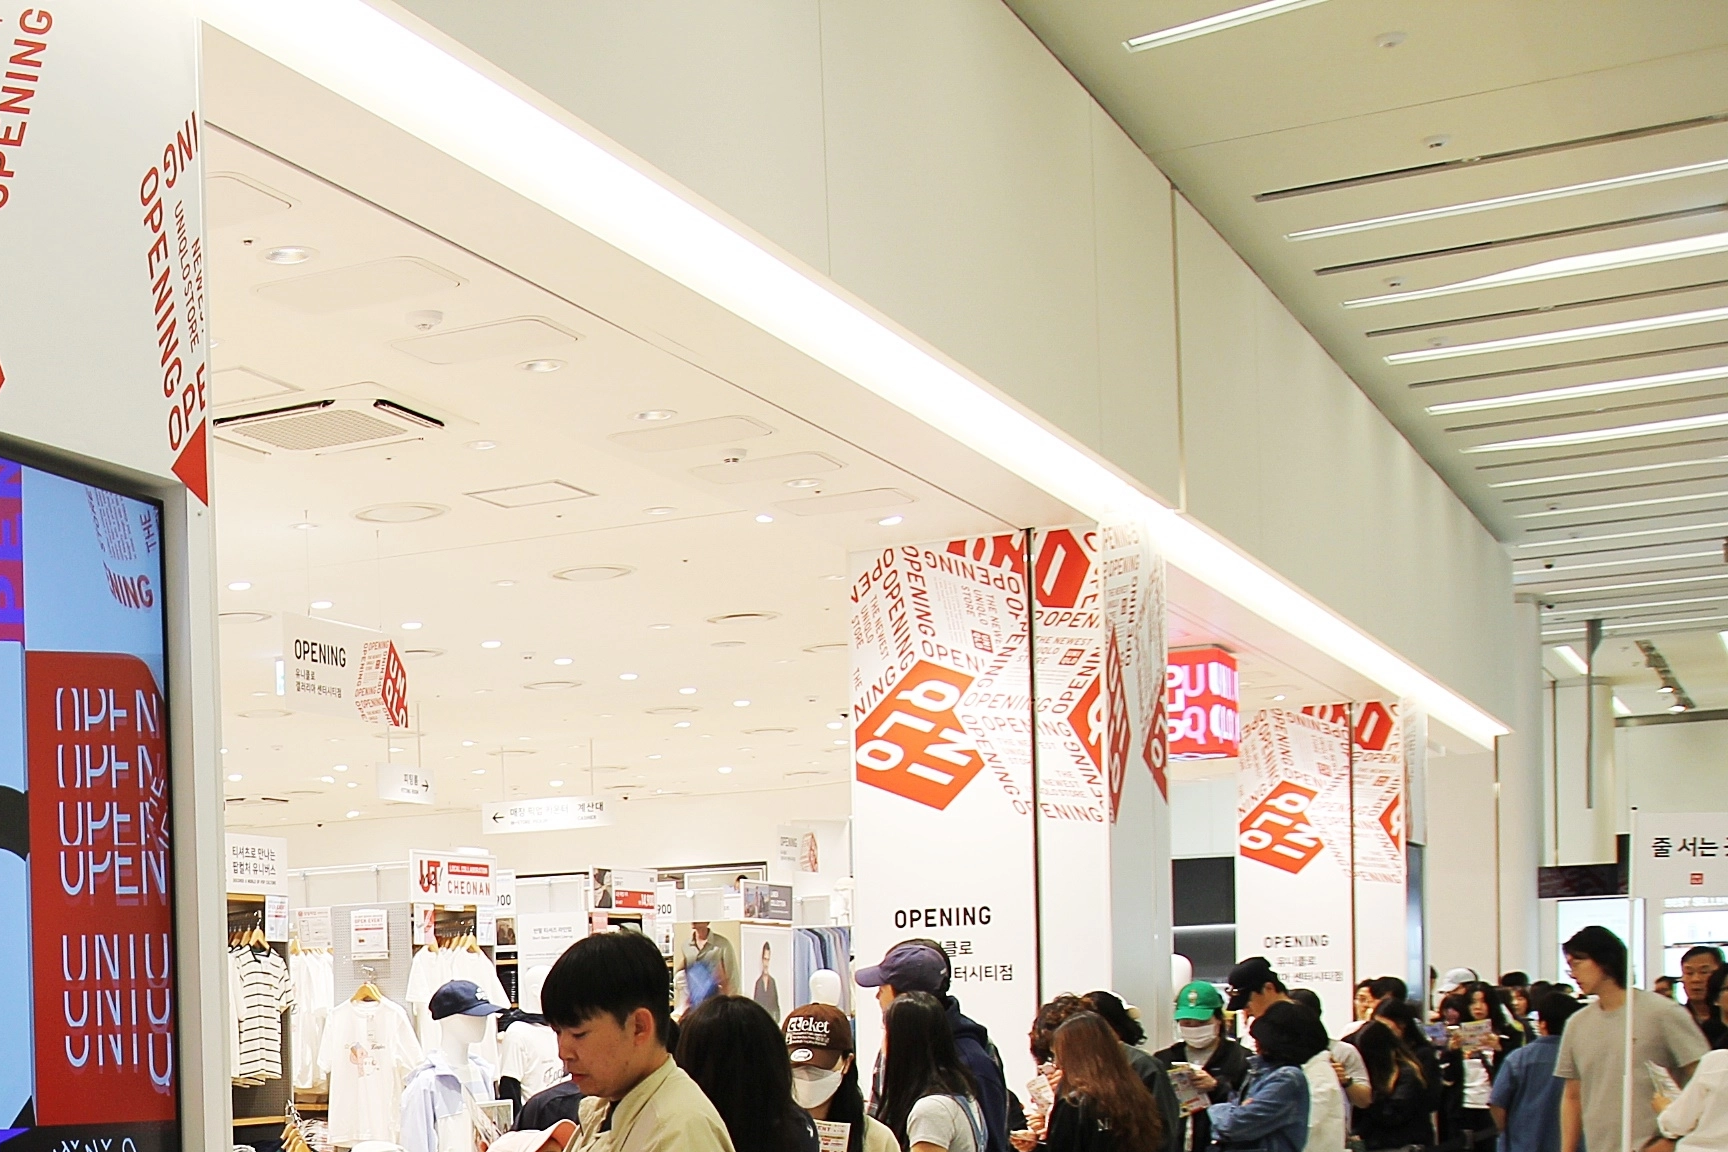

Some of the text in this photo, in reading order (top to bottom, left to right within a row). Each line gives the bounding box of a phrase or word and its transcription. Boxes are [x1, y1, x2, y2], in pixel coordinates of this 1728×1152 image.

[140, 166, 183, 399] OPENING
[139, 509, 157, 554] THE
[883, 569, 915, 671] OPENING
[1055, 635, 1094, 646] NEWEST
[294, 638, 347, 668] OPENING
[295, 668, 315, 681] 유니클로
[317, 685, 342, 699] 센터시티점
[961, 714, 1020, 797] OPENING
[509, 807, 525, 817] 매장
[577, 801, 604, 813] 계산대
[232, 846, 276, 862] 티셔츠로 만나는
[1651, 837, 1673, 857] 줄
[1677, 836, 1719, 857] 서는
[252, 862, 277, 876] 유니버스
[447, 880, 491, 896] CHEONAN
[895, 905, 992, 929] OPENING
[1264, 934, 1330, 949] OPENING
[953, 964, 1014, 984] 터시티점
